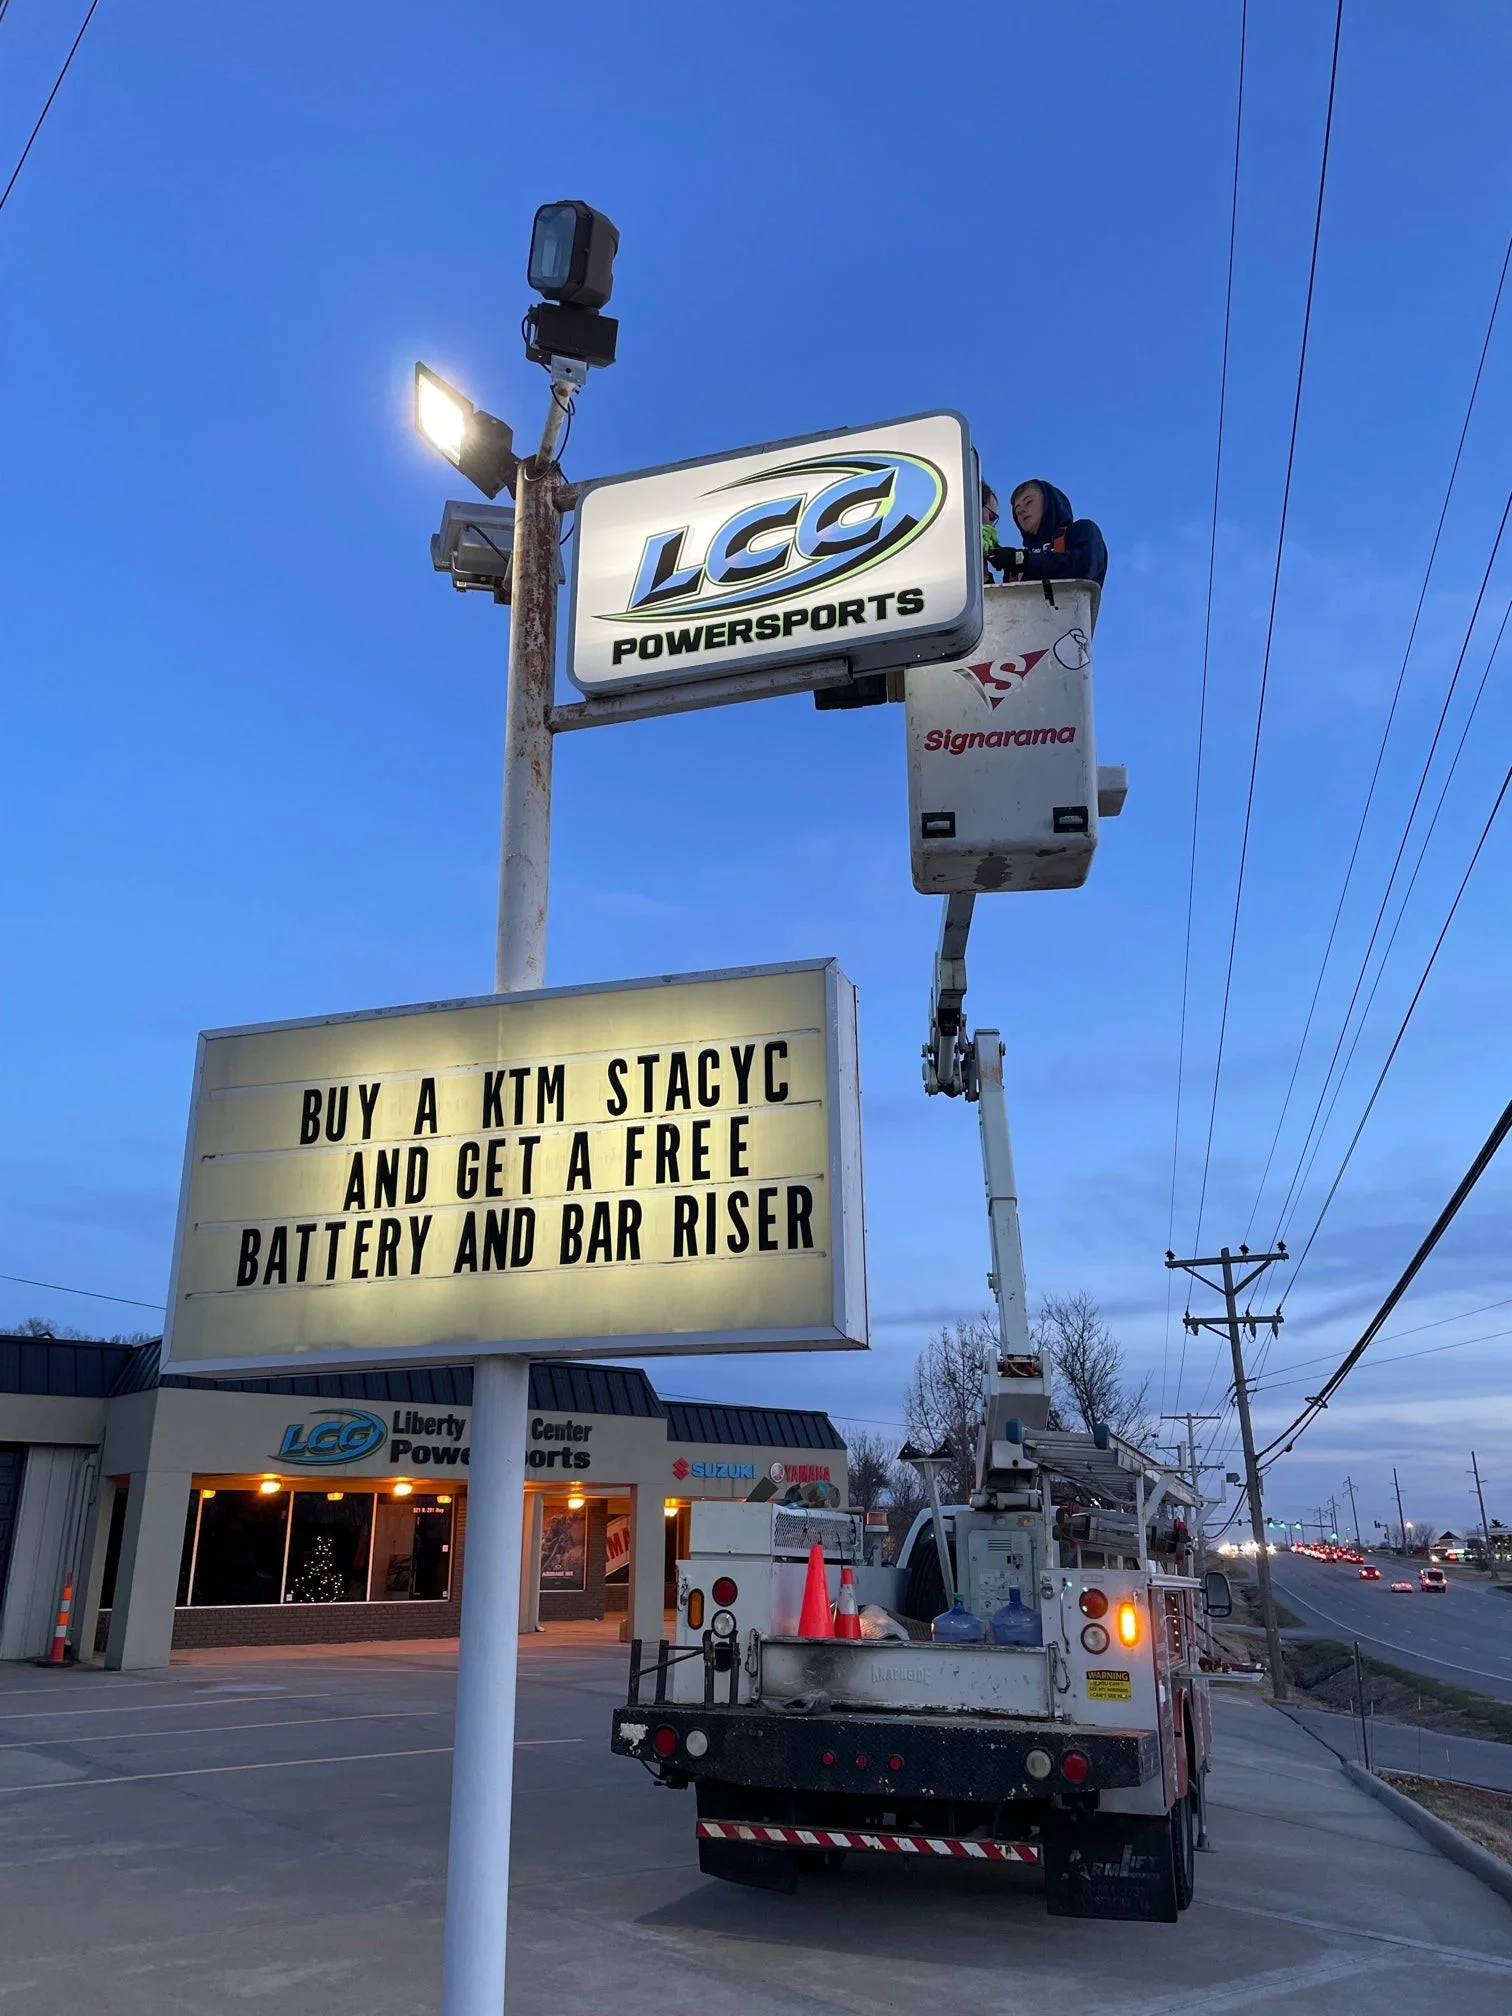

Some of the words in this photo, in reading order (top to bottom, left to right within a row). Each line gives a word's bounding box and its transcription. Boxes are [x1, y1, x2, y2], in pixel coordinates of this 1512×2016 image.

[628, 466, 900, 612] LCC
[612, 588, 925, 665] POWERSPORTS
[923, 726, 1076, 756] Signarama
[299, 1082, 381, 1145] BUY
[413, 1077, 438, 1135] A
[482, 1064, 565, 1129] KTM
[606, 1040, 789, 1116] STACYC
[343, 1146, 429, 1211] AND
[456, 1135, 541, 1200] GET
[566, 1131, 592, 1192] A
[625, 1115, 750, 1186] FREE
[236, 1214, 433, 1287] BATTERY
[453, 1207, 536, 1274] AND
[559, 1199, 642, 1265] BAR
[673, 1185, 814, 1258] RISER
[279, 1418, 380, 1458] LCC
[392, 1410, 467, 1442] Liberty
[531, 1417, 593, 1442] Center
[691, 1462, 759, 1480] SUZUKI
[784, 1464, 831, 1483] YAMAHA
[1088, 1671, 1128, 1681] WARNING
